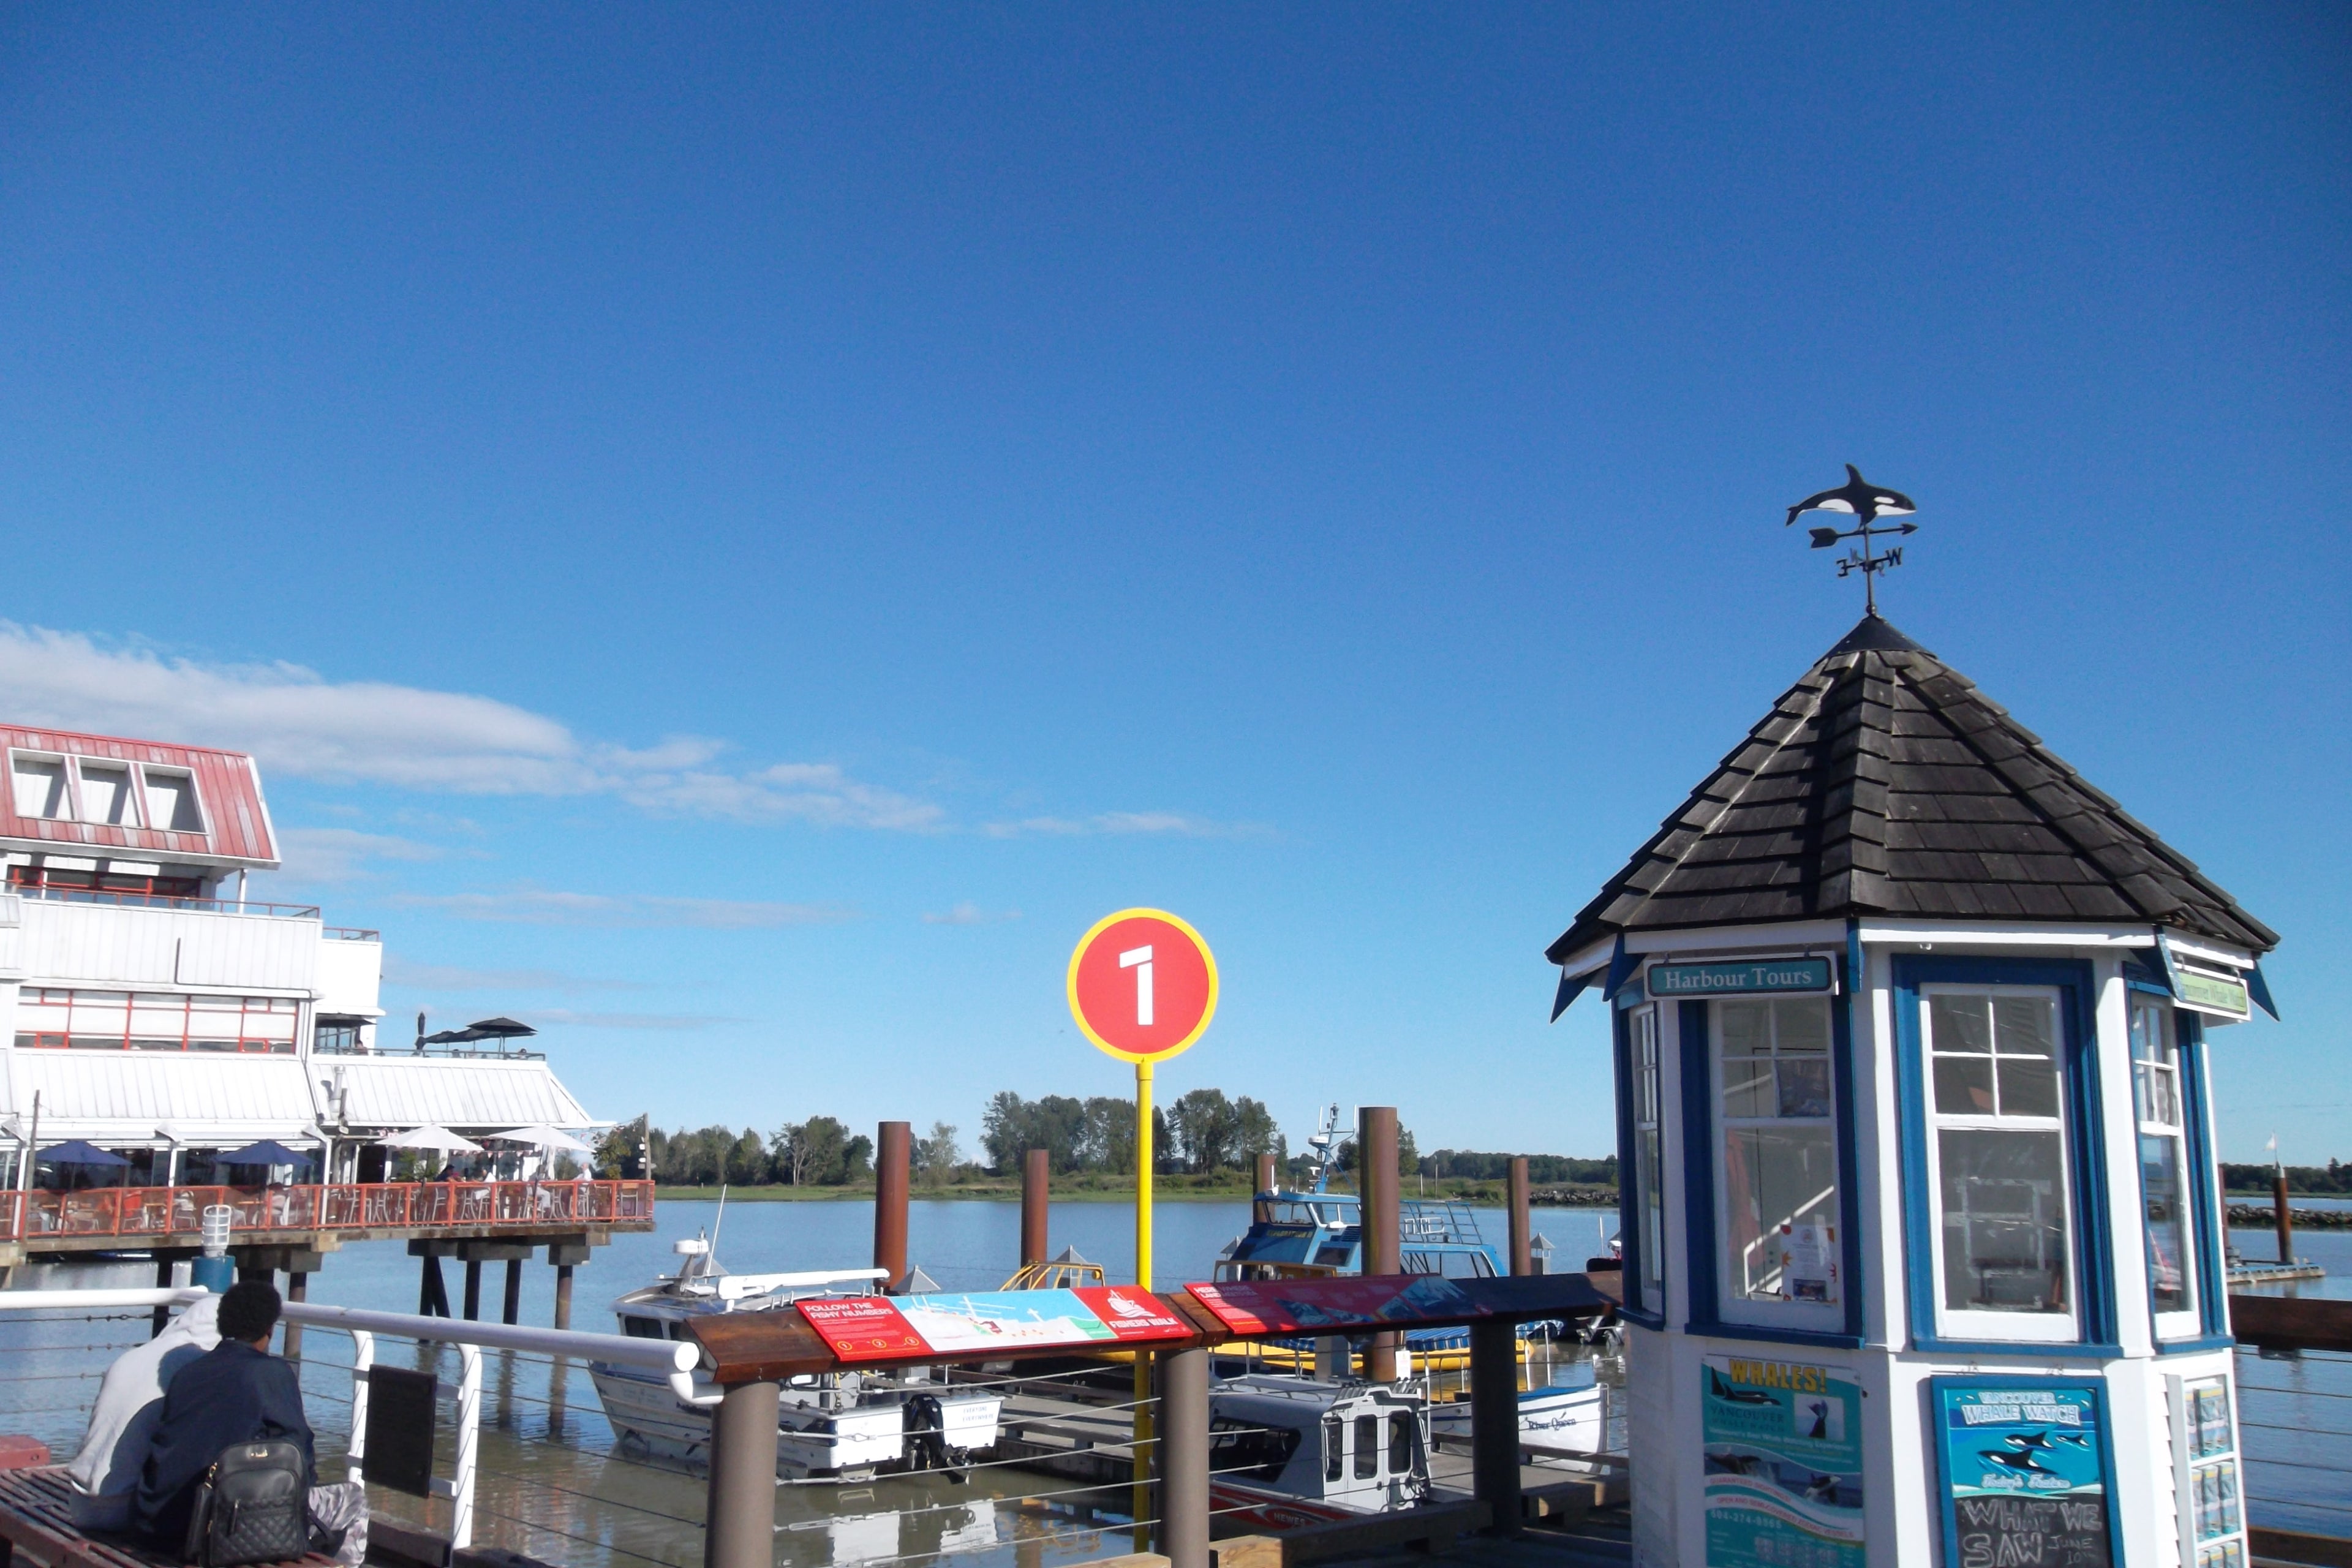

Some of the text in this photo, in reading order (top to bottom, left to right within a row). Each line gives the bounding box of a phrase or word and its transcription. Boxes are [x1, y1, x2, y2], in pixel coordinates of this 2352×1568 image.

[1119, 944, 1153, 1025] 1
[1664, 967, 1813, 990] Harbour Tours
[804, 1303, 851, 1313] FOLLOW
[810, 1308, 894, 1319] FISHY NUMBERS
[1108, 1317, 1179, 1329] FISHERS WALK
[1728, 1358, 1827, 1393] WHALES!
[1978, 1392, 2057, 1404] VANCOUVER
[1711, 1406, 1784, 1424] VANCOUVER
[1961, 1404, 2081, 1425] WHALE WATCH
[1964, 1499, 2103, 1533] WHAT WE
[1963, 1532, 2094, 1568] SAW JUNE
